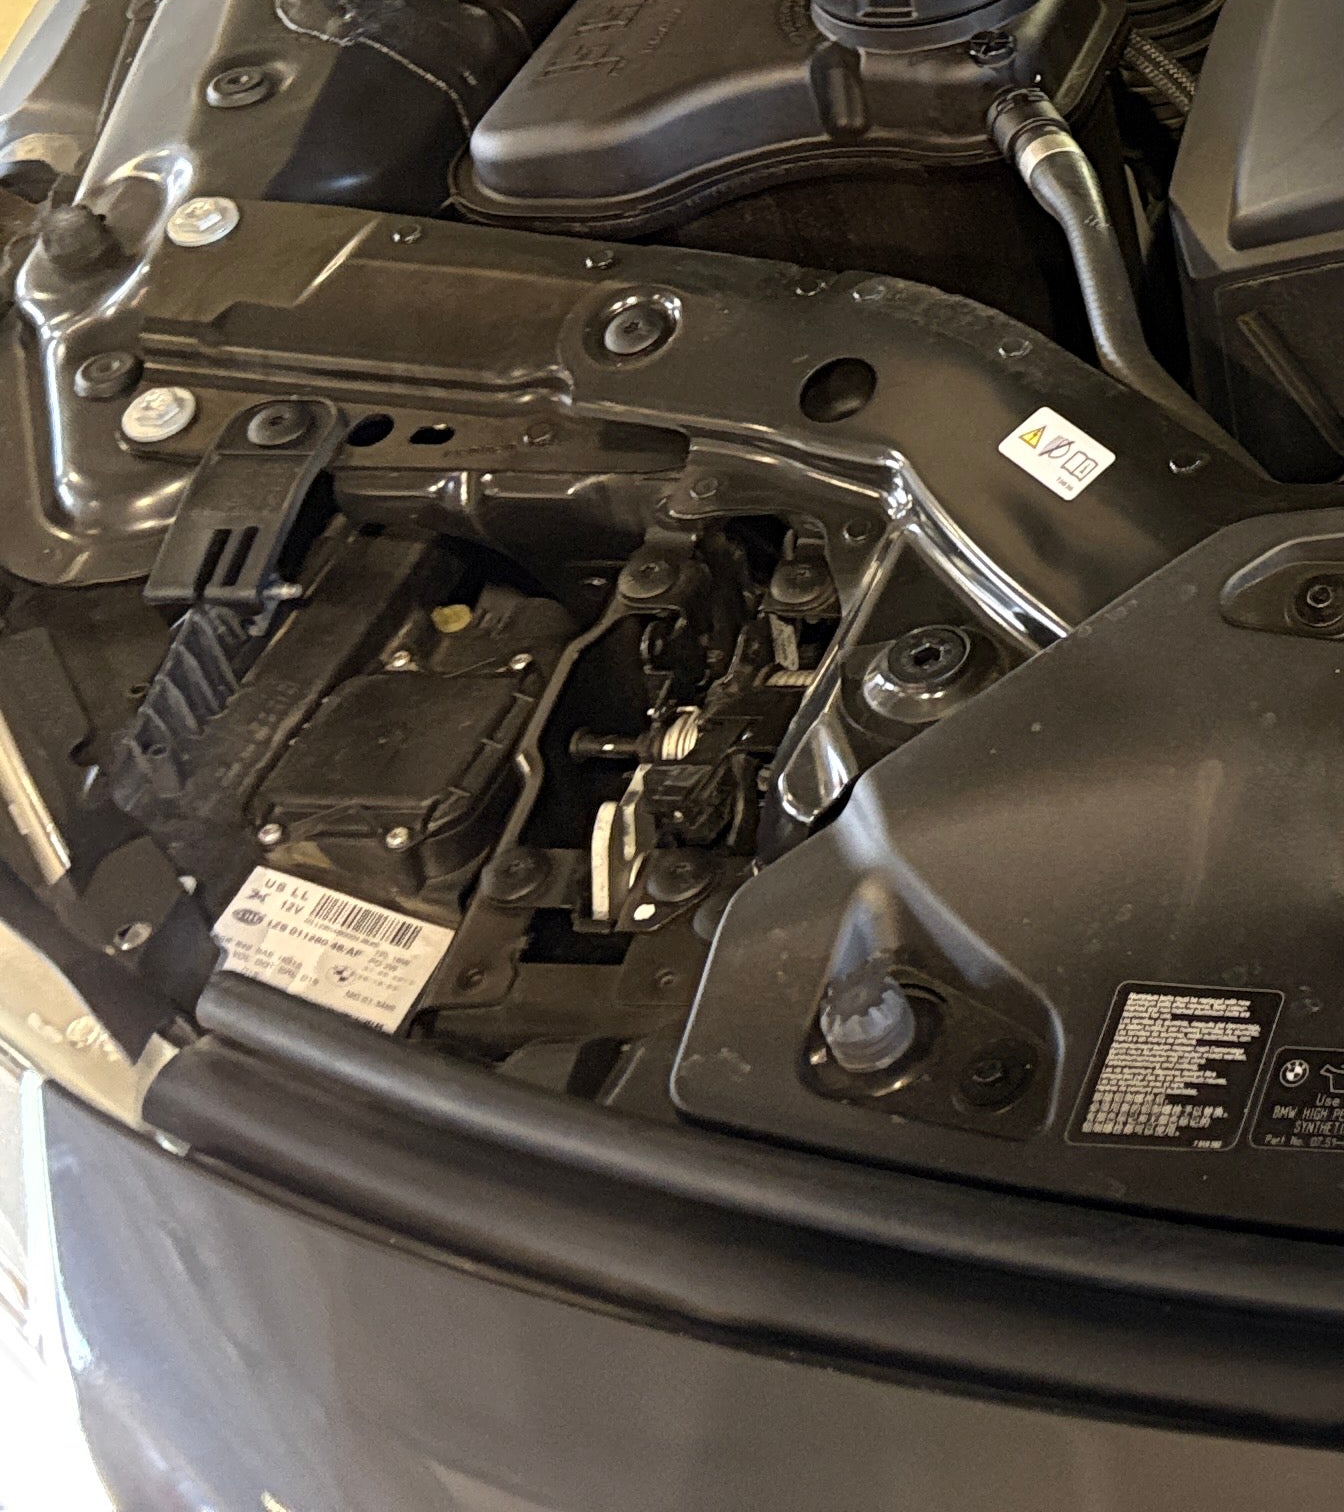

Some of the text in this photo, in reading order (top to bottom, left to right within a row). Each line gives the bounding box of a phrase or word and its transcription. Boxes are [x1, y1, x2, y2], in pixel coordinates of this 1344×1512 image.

[1316, 1093, 1340, 1107] Use
[1272, 1105, 1296, 1119] BMW
[1302, 1106, 1327, 1120] HIGH
